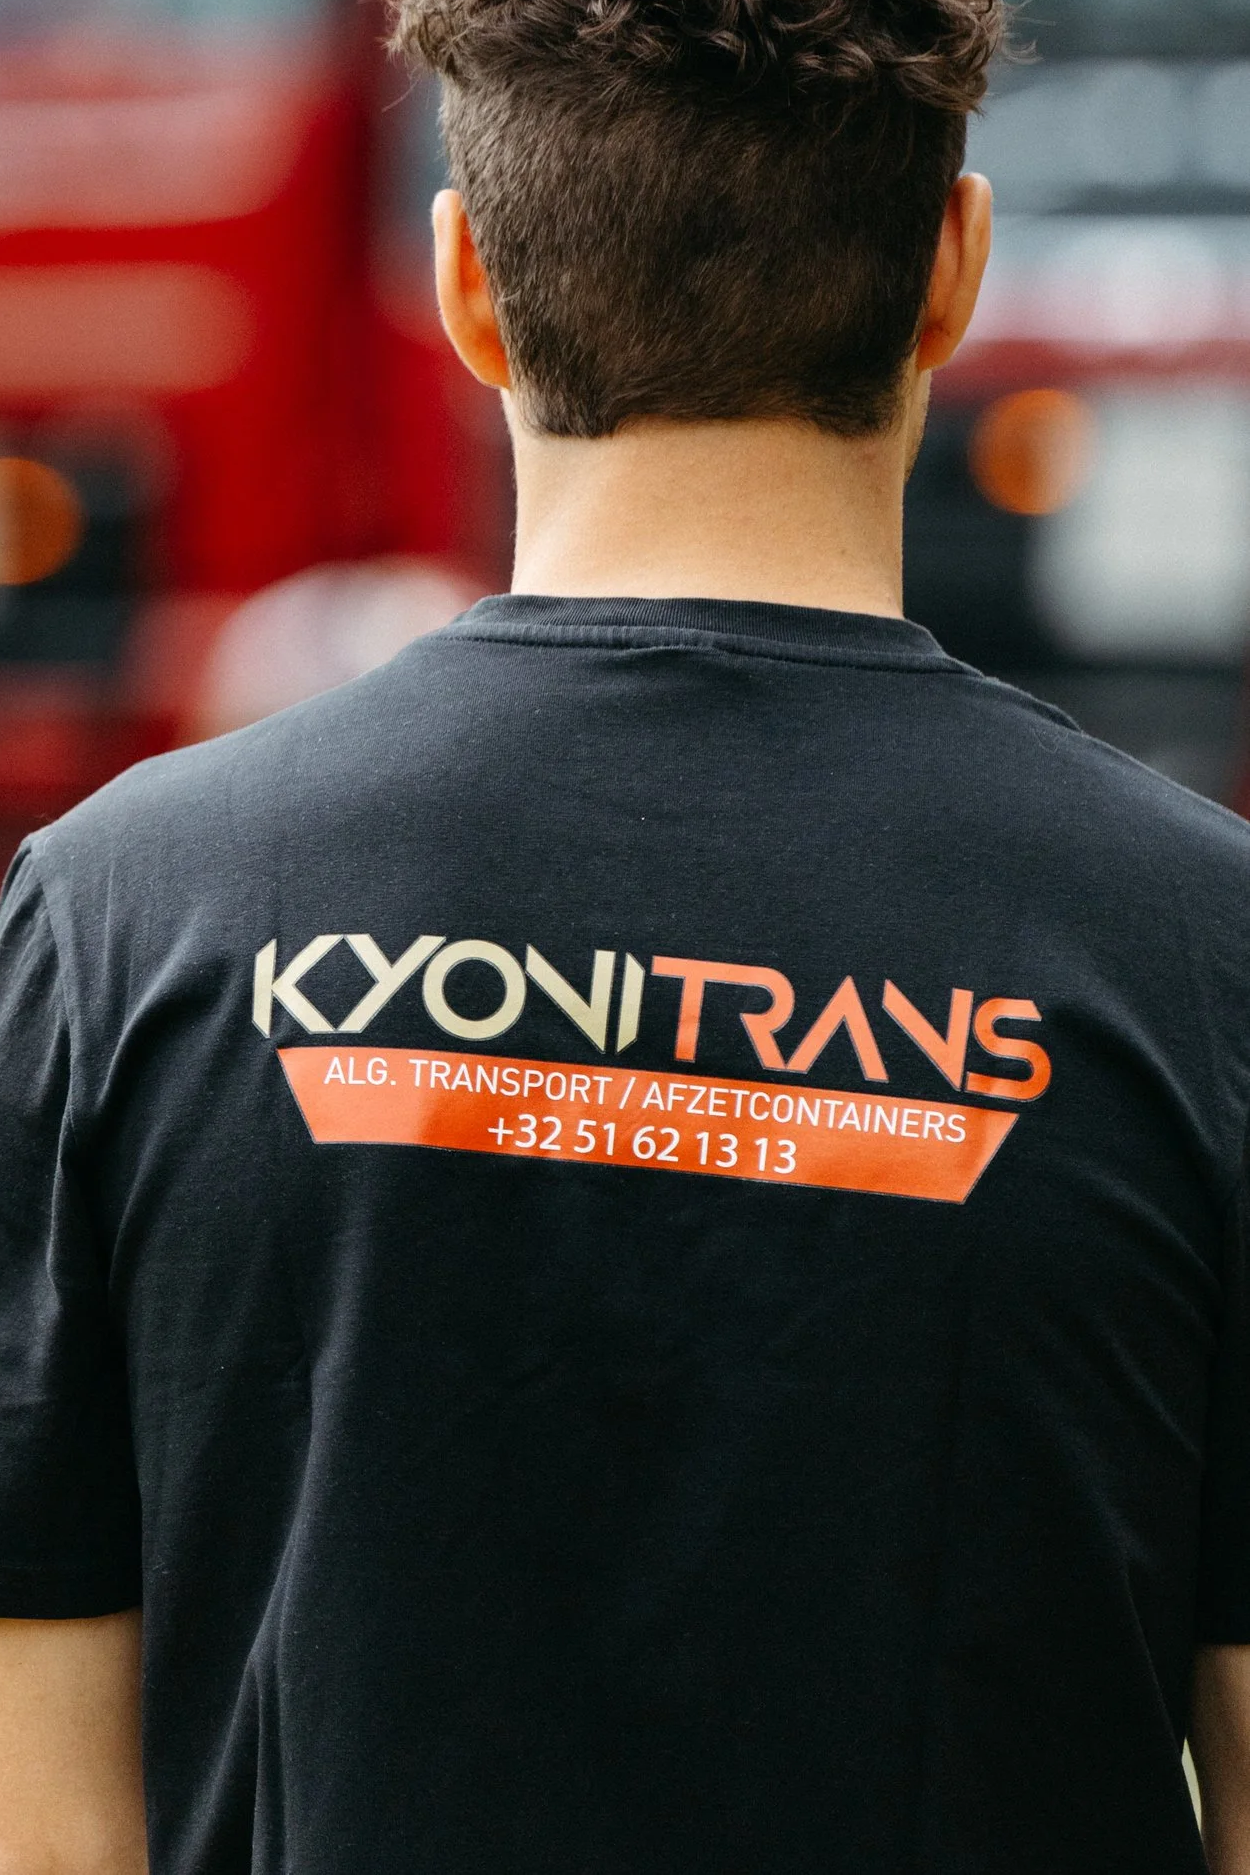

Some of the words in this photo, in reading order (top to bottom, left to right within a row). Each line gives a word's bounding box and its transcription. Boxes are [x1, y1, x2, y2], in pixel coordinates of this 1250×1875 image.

[323, 1056, 397, 1087] ALG.
[409, 1059, 612, 1104] TRANSPORT
[618, 1076, 635, 1110] /
[642, 1081, 967, 1143] AFZETCONTAINERS
[488, 1114, 562, 1151] +32
[573, 1121, 617, 1154] 51
[632, 1127, 680, 1161] 62
[696, 1132, 739, 1167] 13
[754, 1137, 797, 1174] 13
